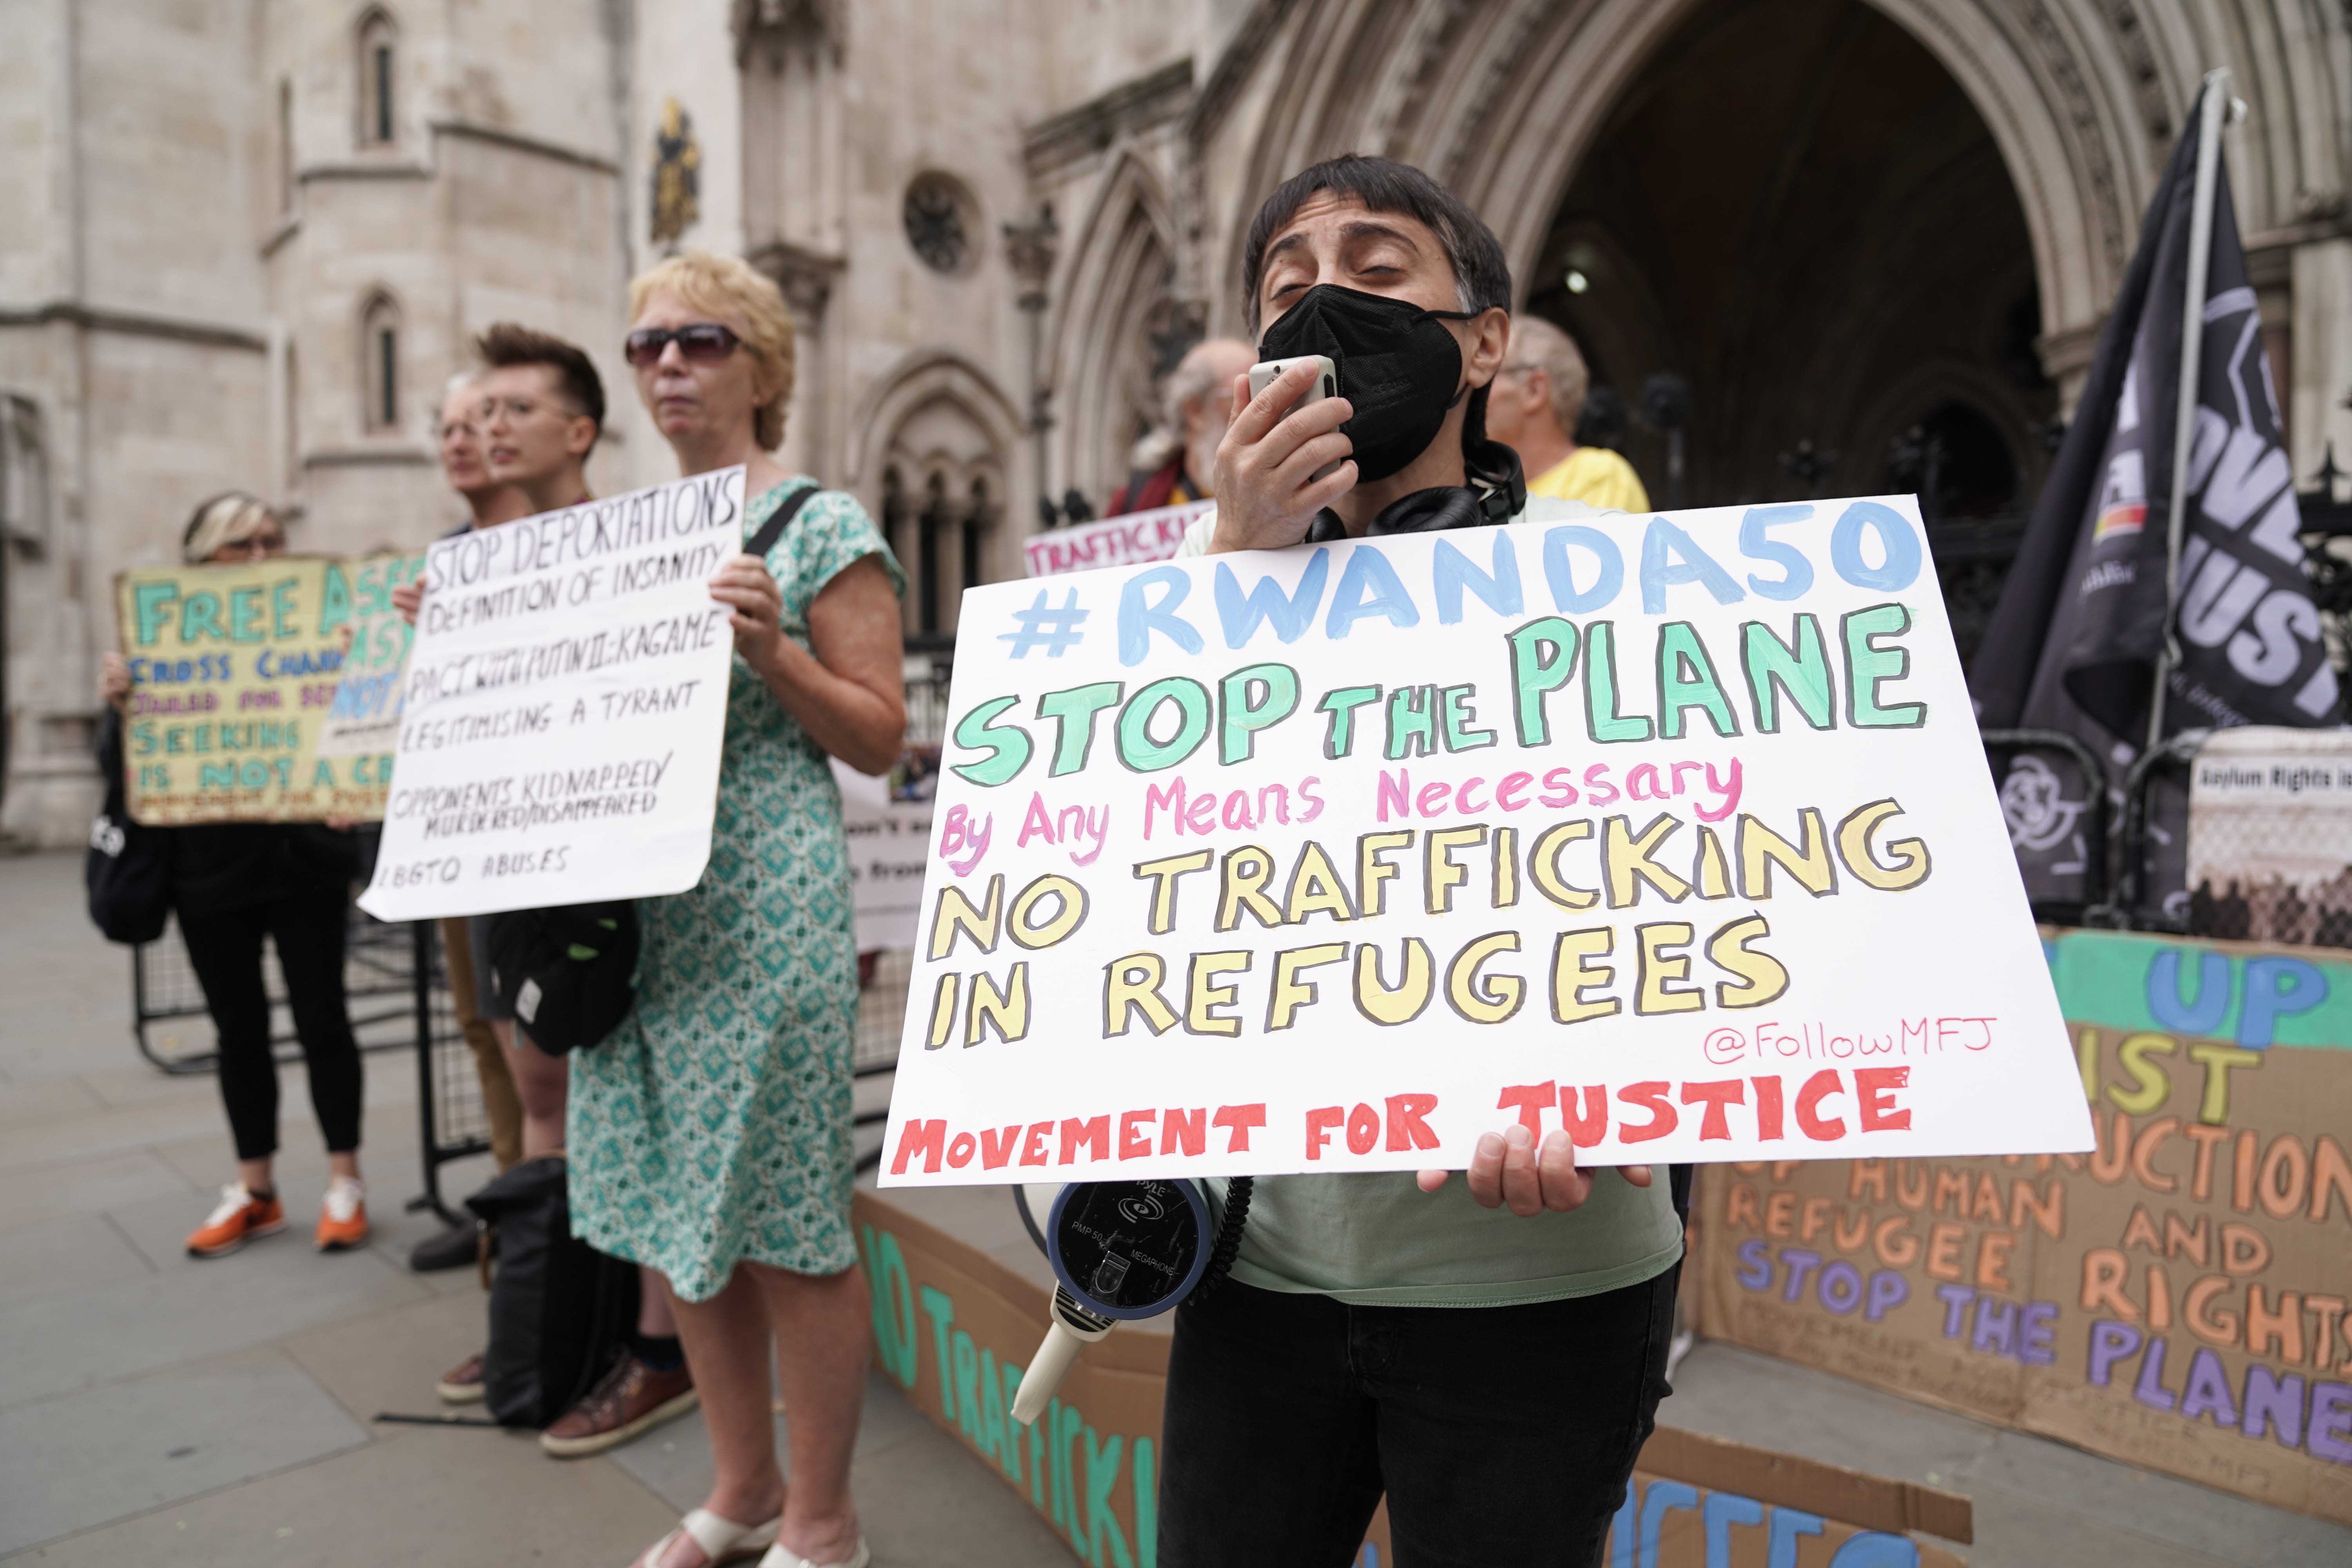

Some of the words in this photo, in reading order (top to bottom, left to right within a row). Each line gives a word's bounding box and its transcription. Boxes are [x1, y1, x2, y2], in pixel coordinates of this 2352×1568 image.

[427, 527, 502, 594] STOP
[513, 472, 742, 575] DEPORTATIONS
[1029, 513, 1199, 575] TRAFFICKI
[135, 576, 299, 645] FREE
[427, 577, 563, 637] DEFINITION
[568, 565, 605, 606] OF
[613, 540, 729, 595] INSANITY
[130, 653, 232, 682] CROSS
[409, 654, 474, 702] PACT
[949, 662, 1301, 788] STOP
[1316, 683, 1498, 760] THE
[1504, 602, 1929, 748] PLANE
[133, 720, 299, 755] SEEKING
[401, 703, 552, 753] LEGITIMISING
[571, 698, 586, 725] A
[601, 680, 701, 722] TYRANT
[140, 764, 170, 788] IS
[201, 757, 295, 790] NOT
[314, 759, 334, 788] A
[392, 778, 515, 819] OPPONENTS
[2202, 765, 2261, 791] Asylum
[2271, 764, 2331, 793] Rights
[941, 804, 992, 877] By
[1018, 791, 1109, 866] Any
[1144, 776, 1325, 840] Means
[1377, 757, 1742, 822] Necessary
[378, 856, 461, 889] LBGTQ
[482, 845, 571, 878] ABUSES
[927, 873, 1090, 962] NO
[1133, 797, 1932, 935] TRAFFICKING
[925, 961, 1031, 1050] IN
[1102, 909, 1790, 1039] REFUGEES
[2144, 947, 2328, 1049] UP
[1704, 1017, 1997, 1064] @FollowMFJ
[890, 1103, 1266, 1174] MOVEMENT
[1306, 1094, 1441, 1160] FOR
[1072, 1221, 1091, 1235] PMP
[1092, 1231, 1103, 1241] 50
[1727, 1183, 2016, 1289] REFUGEE
[1849, 1158, 2063, 1240] HUMAN
[2123, 1202, 2270, 1273] AND
[1131, 1250, 1175, 1276] MEGAPHONE
[1736, 1240, 1907, 1321] STOP
[1937, 1284, 2059, 1364] THE
[2089, 1321, 2352, 1463] PLANE
